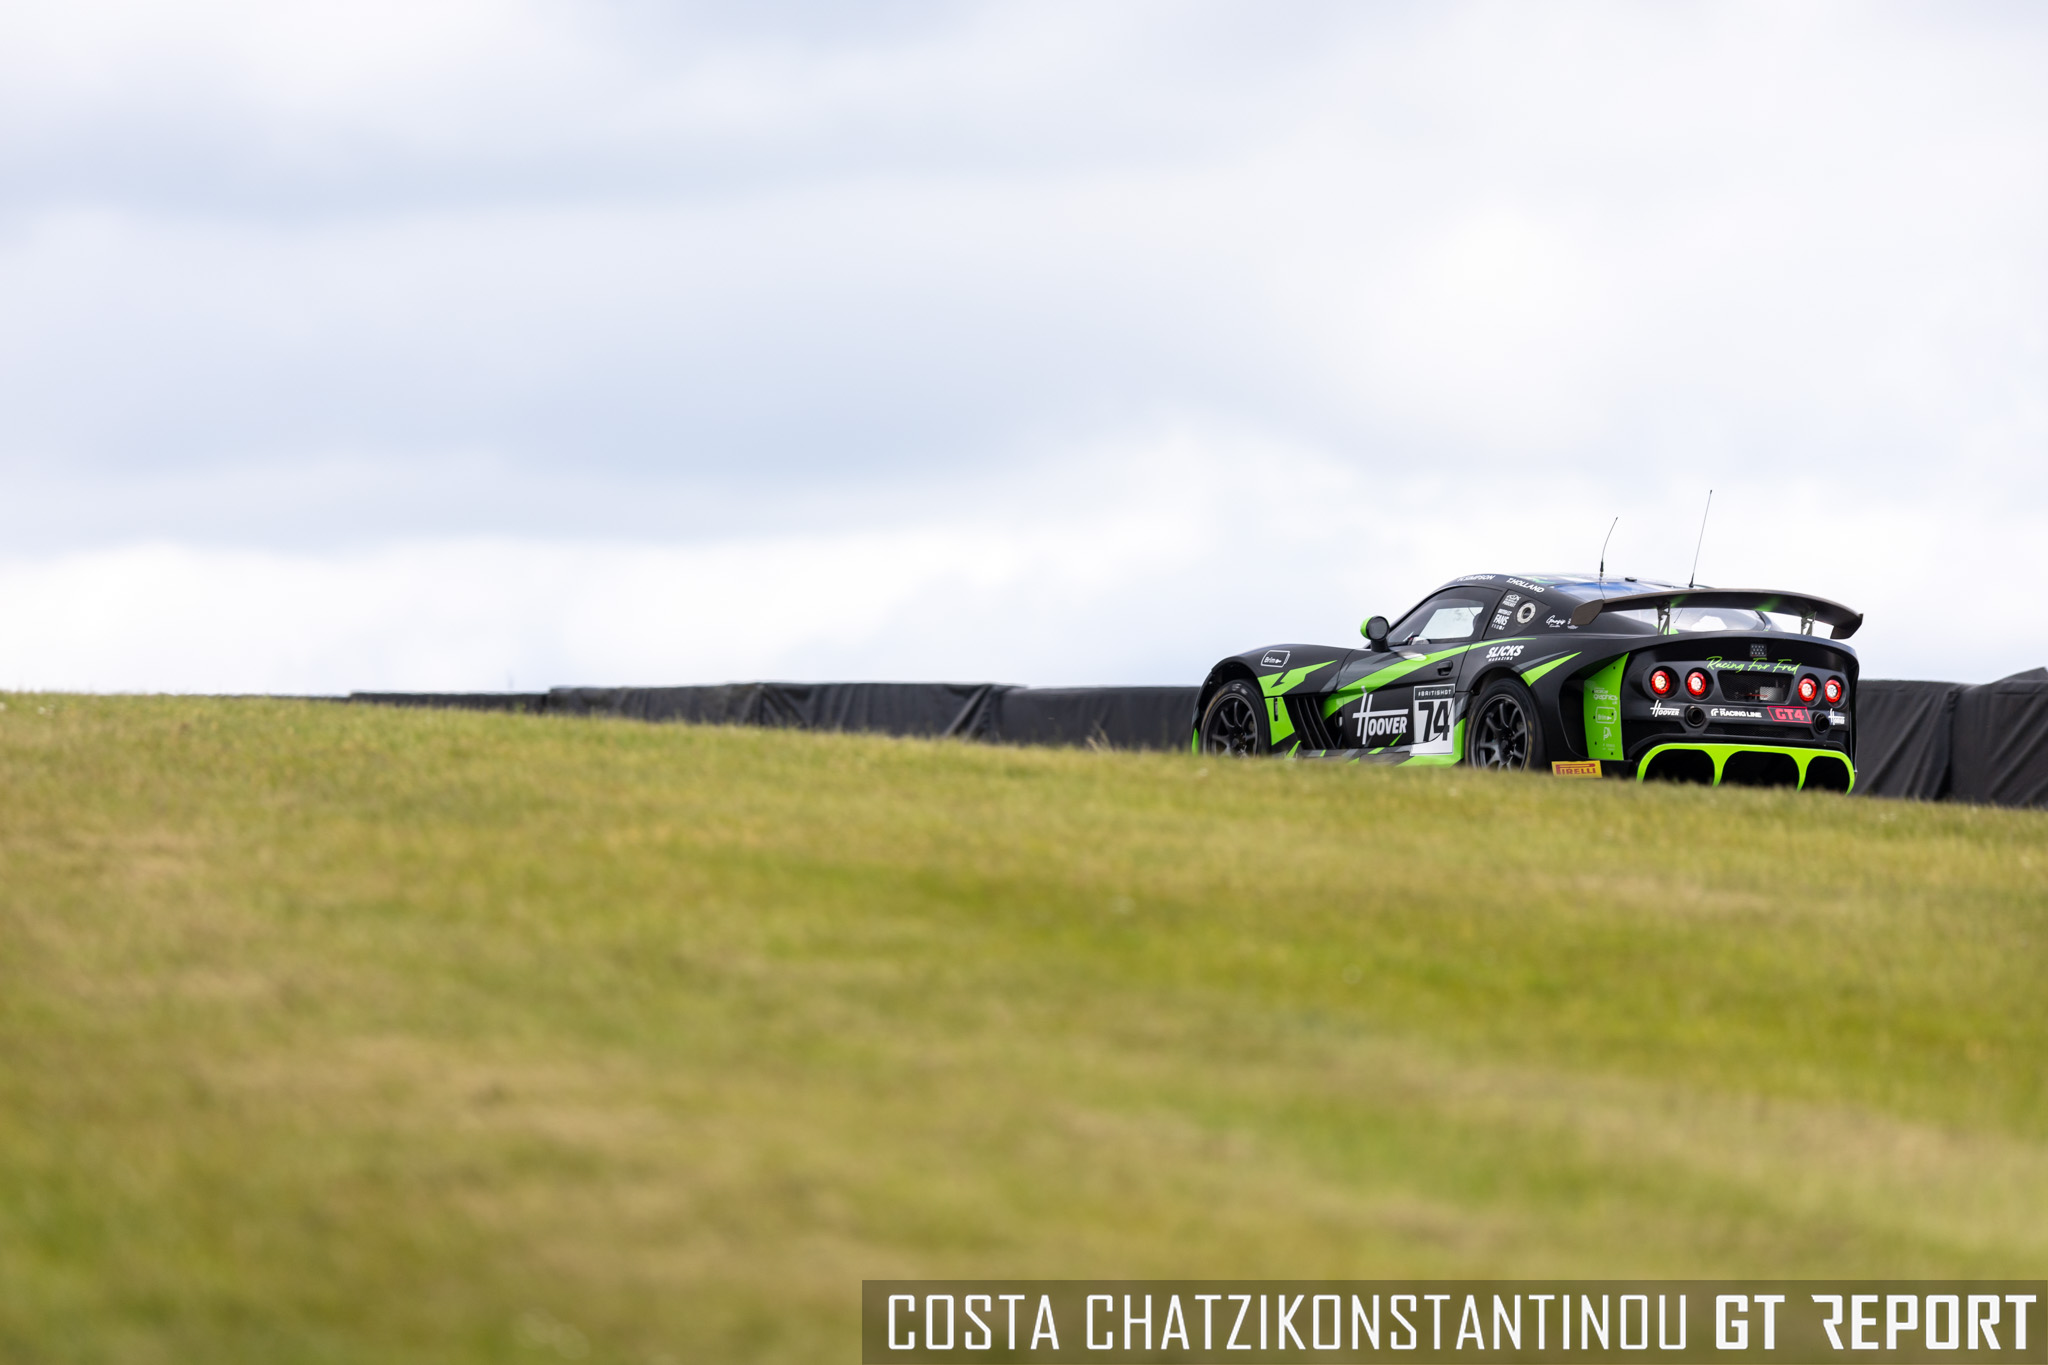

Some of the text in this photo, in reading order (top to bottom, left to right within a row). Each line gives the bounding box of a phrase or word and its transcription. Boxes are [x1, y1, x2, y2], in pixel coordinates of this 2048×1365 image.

[1486, 645, 1525, 658] SLICKS
[1706, 655, 1802, 676] Racing For Fred
[1719, 709, 1763, 718] RACING LINE
[1774, 708, 1805, 721] GT4
[1418, 700, 1450, 742] 74
[1555, 763, 1597, 776] PIRELLI
